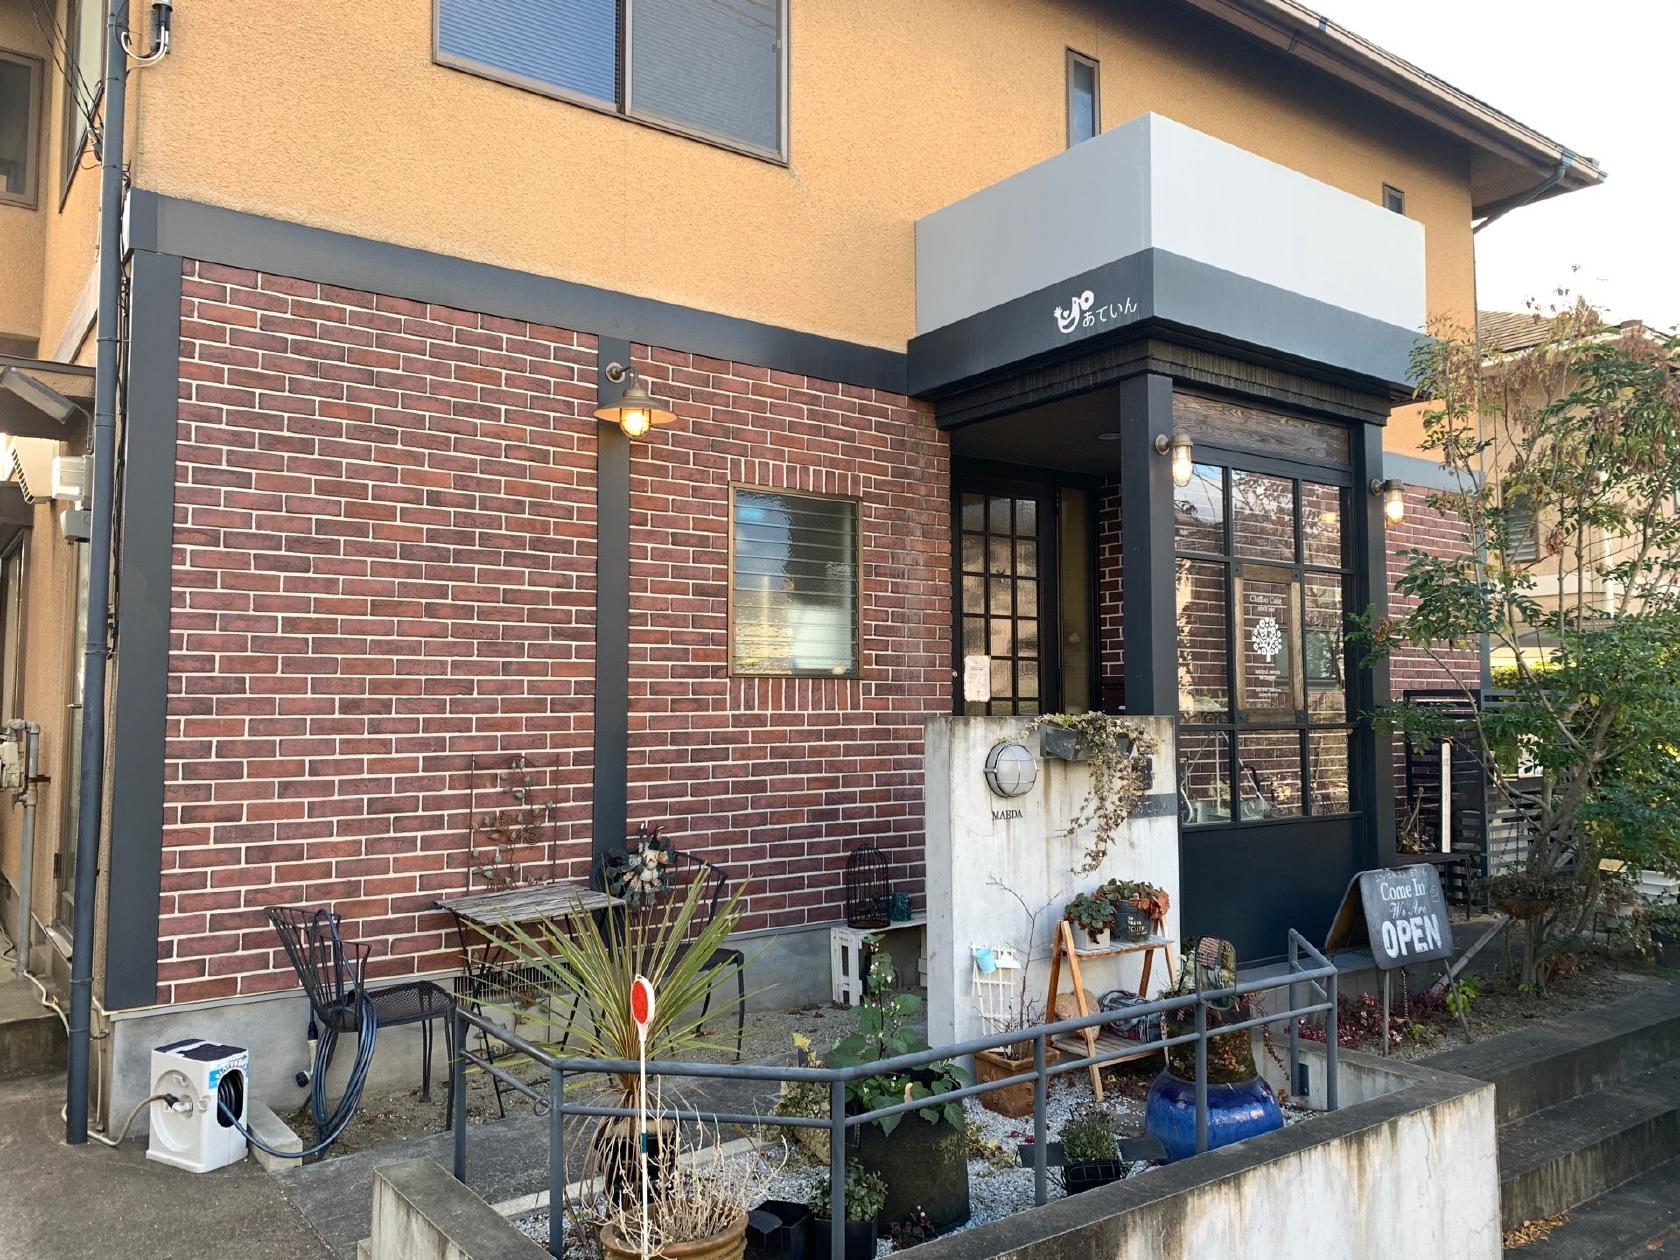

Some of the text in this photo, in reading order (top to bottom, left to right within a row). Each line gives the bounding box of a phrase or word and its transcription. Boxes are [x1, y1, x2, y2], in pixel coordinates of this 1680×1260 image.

[992, 809, 1023, 820] MAEDA
[1380, 878, 1426, 901] Come In
[1382, 914, 1442, 958] OPEN
